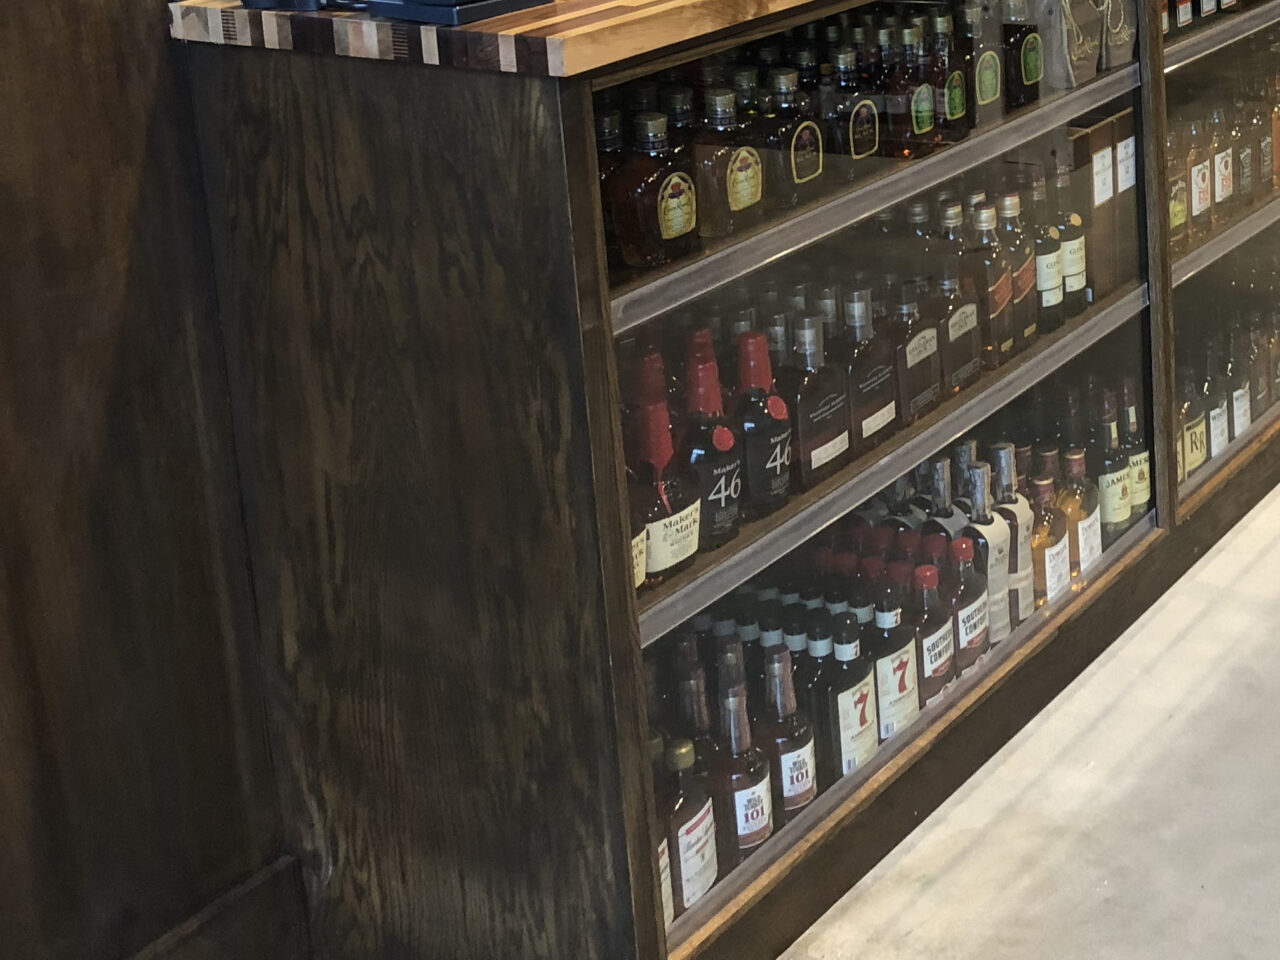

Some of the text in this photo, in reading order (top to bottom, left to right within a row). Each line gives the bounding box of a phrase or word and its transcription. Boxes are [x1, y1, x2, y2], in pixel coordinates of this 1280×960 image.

[708, 468, 742, 508] 46
[893, 656, 910, 694] 7
[854, 690, 870, 728] 7
[788, 770, 809, 785] 101
[744, 809, 765, 824] 101
